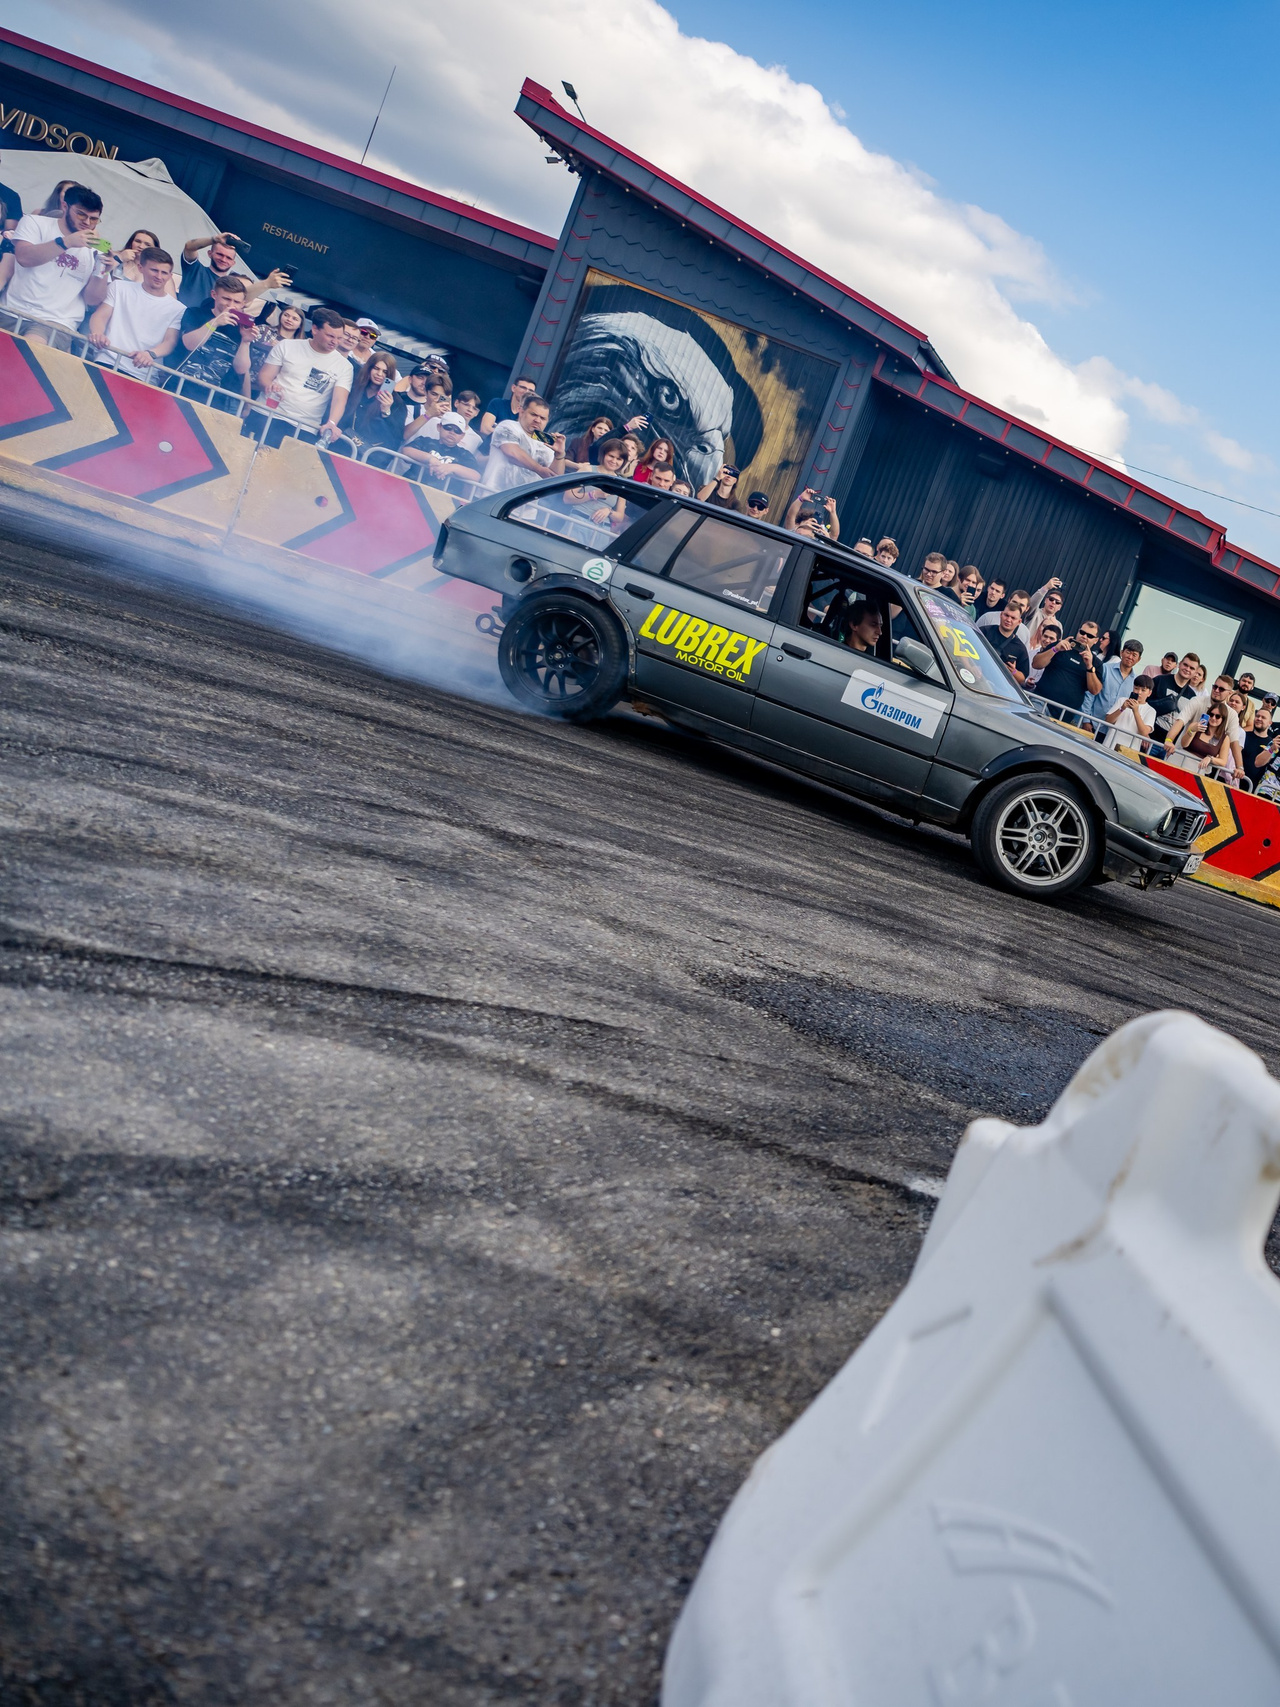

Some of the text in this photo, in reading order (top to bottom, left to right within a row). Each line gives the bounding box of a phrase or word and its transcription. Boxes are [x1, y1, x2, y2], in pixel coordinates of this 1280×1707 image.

[0, 103, 119, 160] VIDSON
[262, 222, 330, 254] RESTAURANT
[639, 603, 768, 675] LUBREX
[940, 625, 980, 660] 25
[676, 651, 745, 683] MOTOR OIL
[876, 701, 922, 729] ГАЗПРОМ
